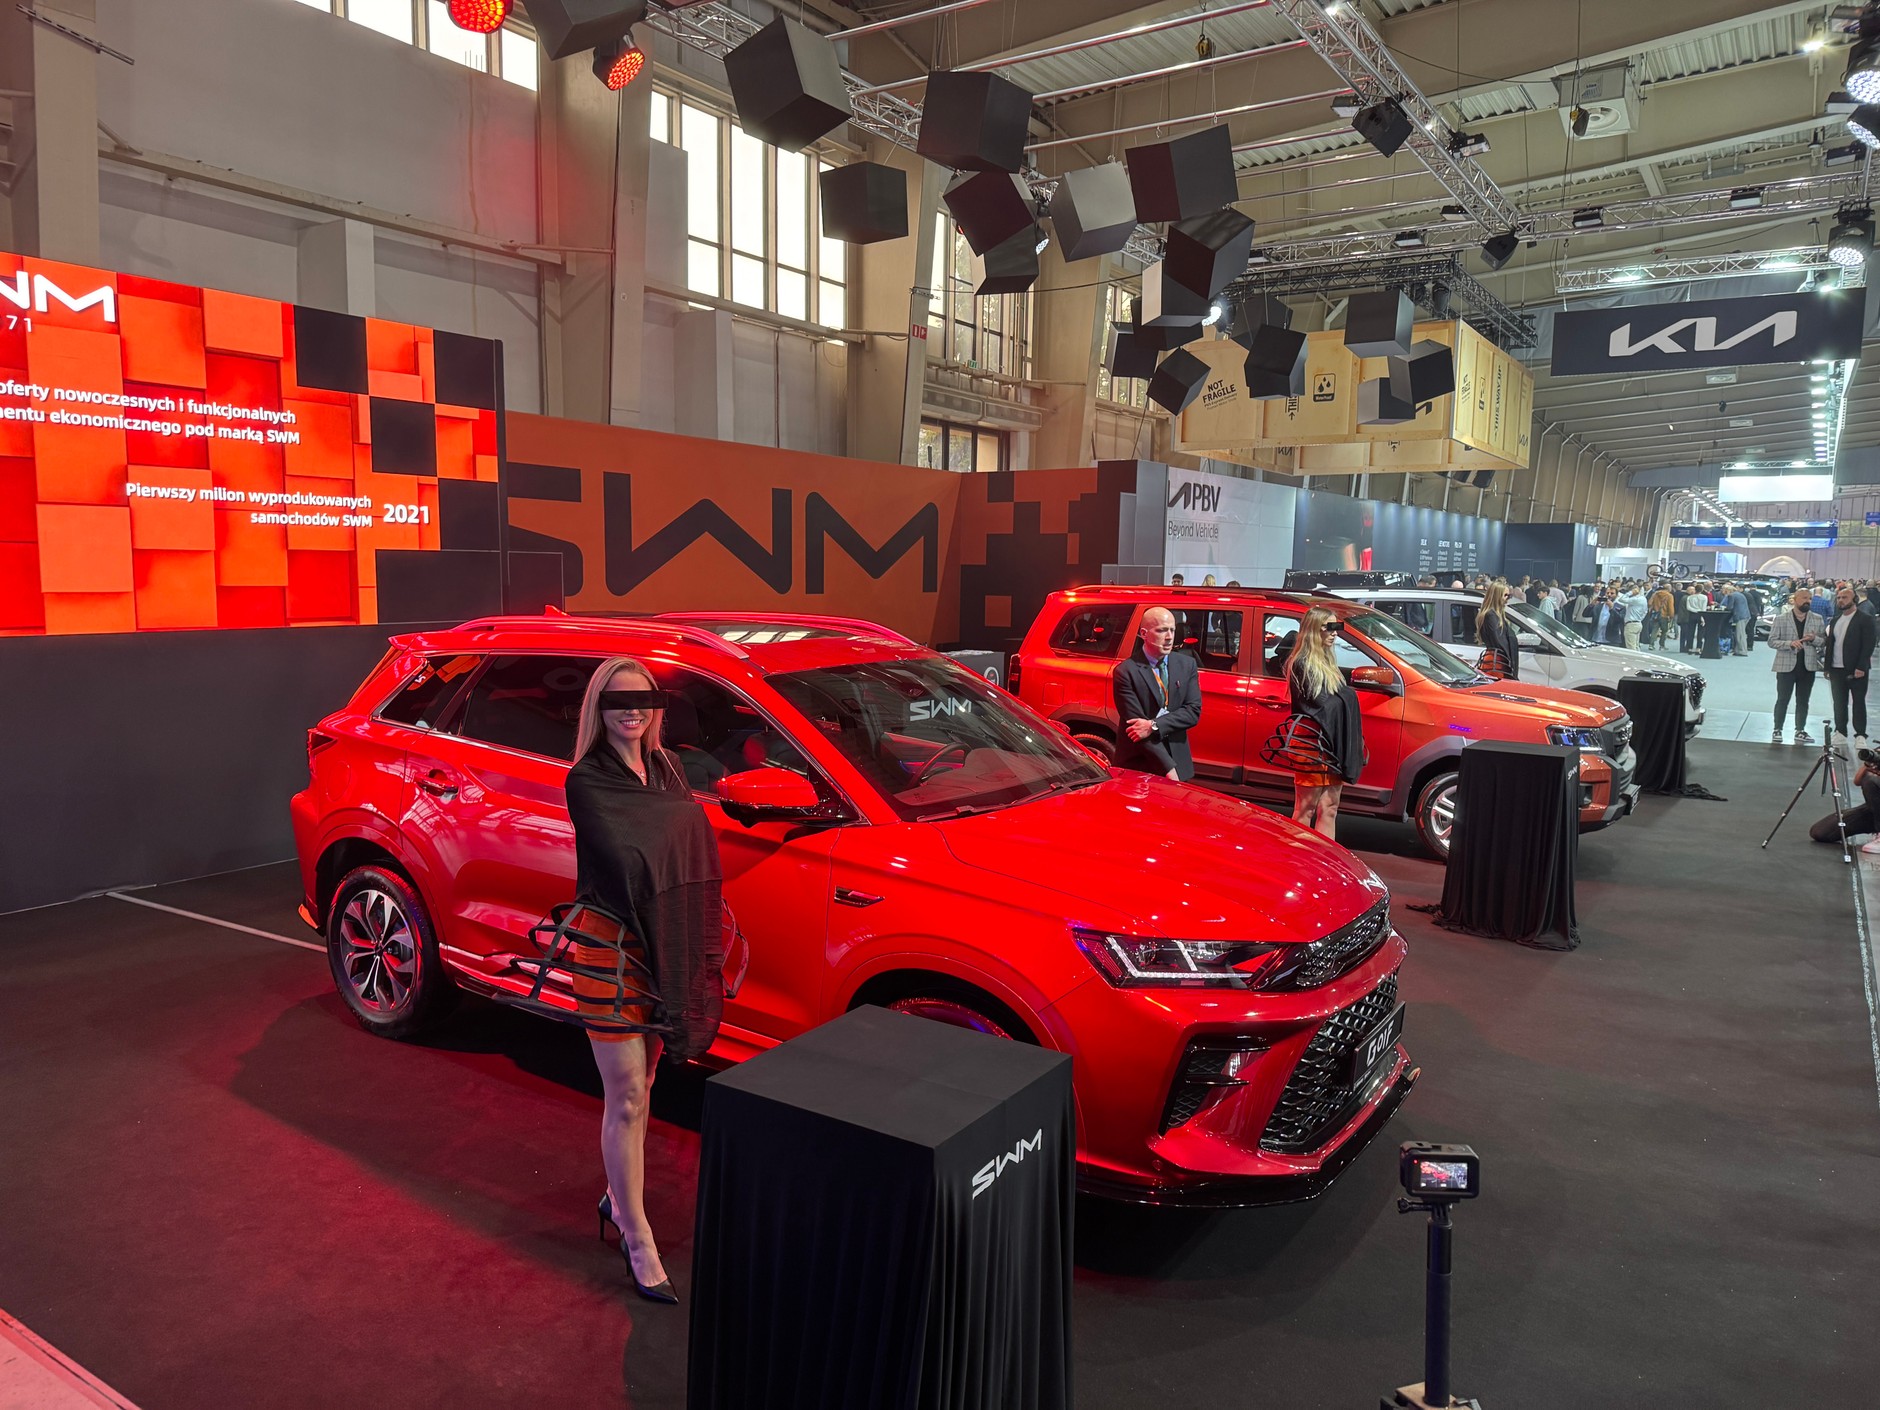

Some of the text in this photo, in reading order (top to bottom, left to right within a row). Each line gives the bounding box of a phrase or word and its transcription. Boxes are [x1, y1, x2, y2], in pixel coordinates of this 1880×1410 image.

[1608, 310, 1798, 357] KIA
[1202, 383, 1237, 404] FRAGILE
[1207, 379, 1224, 393] NOT
[54, 387, 176, 412] nowoczesnych
[179, 398, 184, 412] i
[187, 399, 297, 425] funkcjonalnych
[50, 409, 182, 436] ekonomicznego
[185, 423, 215, 438] pod
[218, 427, 265, 444] marką
[267, 429, 300, 445] SWM
[126, 482, 372, 510] Pierwszy milion wyprodukowanych
[1192, 483, 1221, 512] PBV
[251, 511, 373, 528] samochodów SWM
[383, 503, 430, 524] 2021
[1168, 520, 1219, 540] Beyond Vehicle
[909, 697, 972, 722] SWM
[971, 1128, 1042, 1200] SWM
